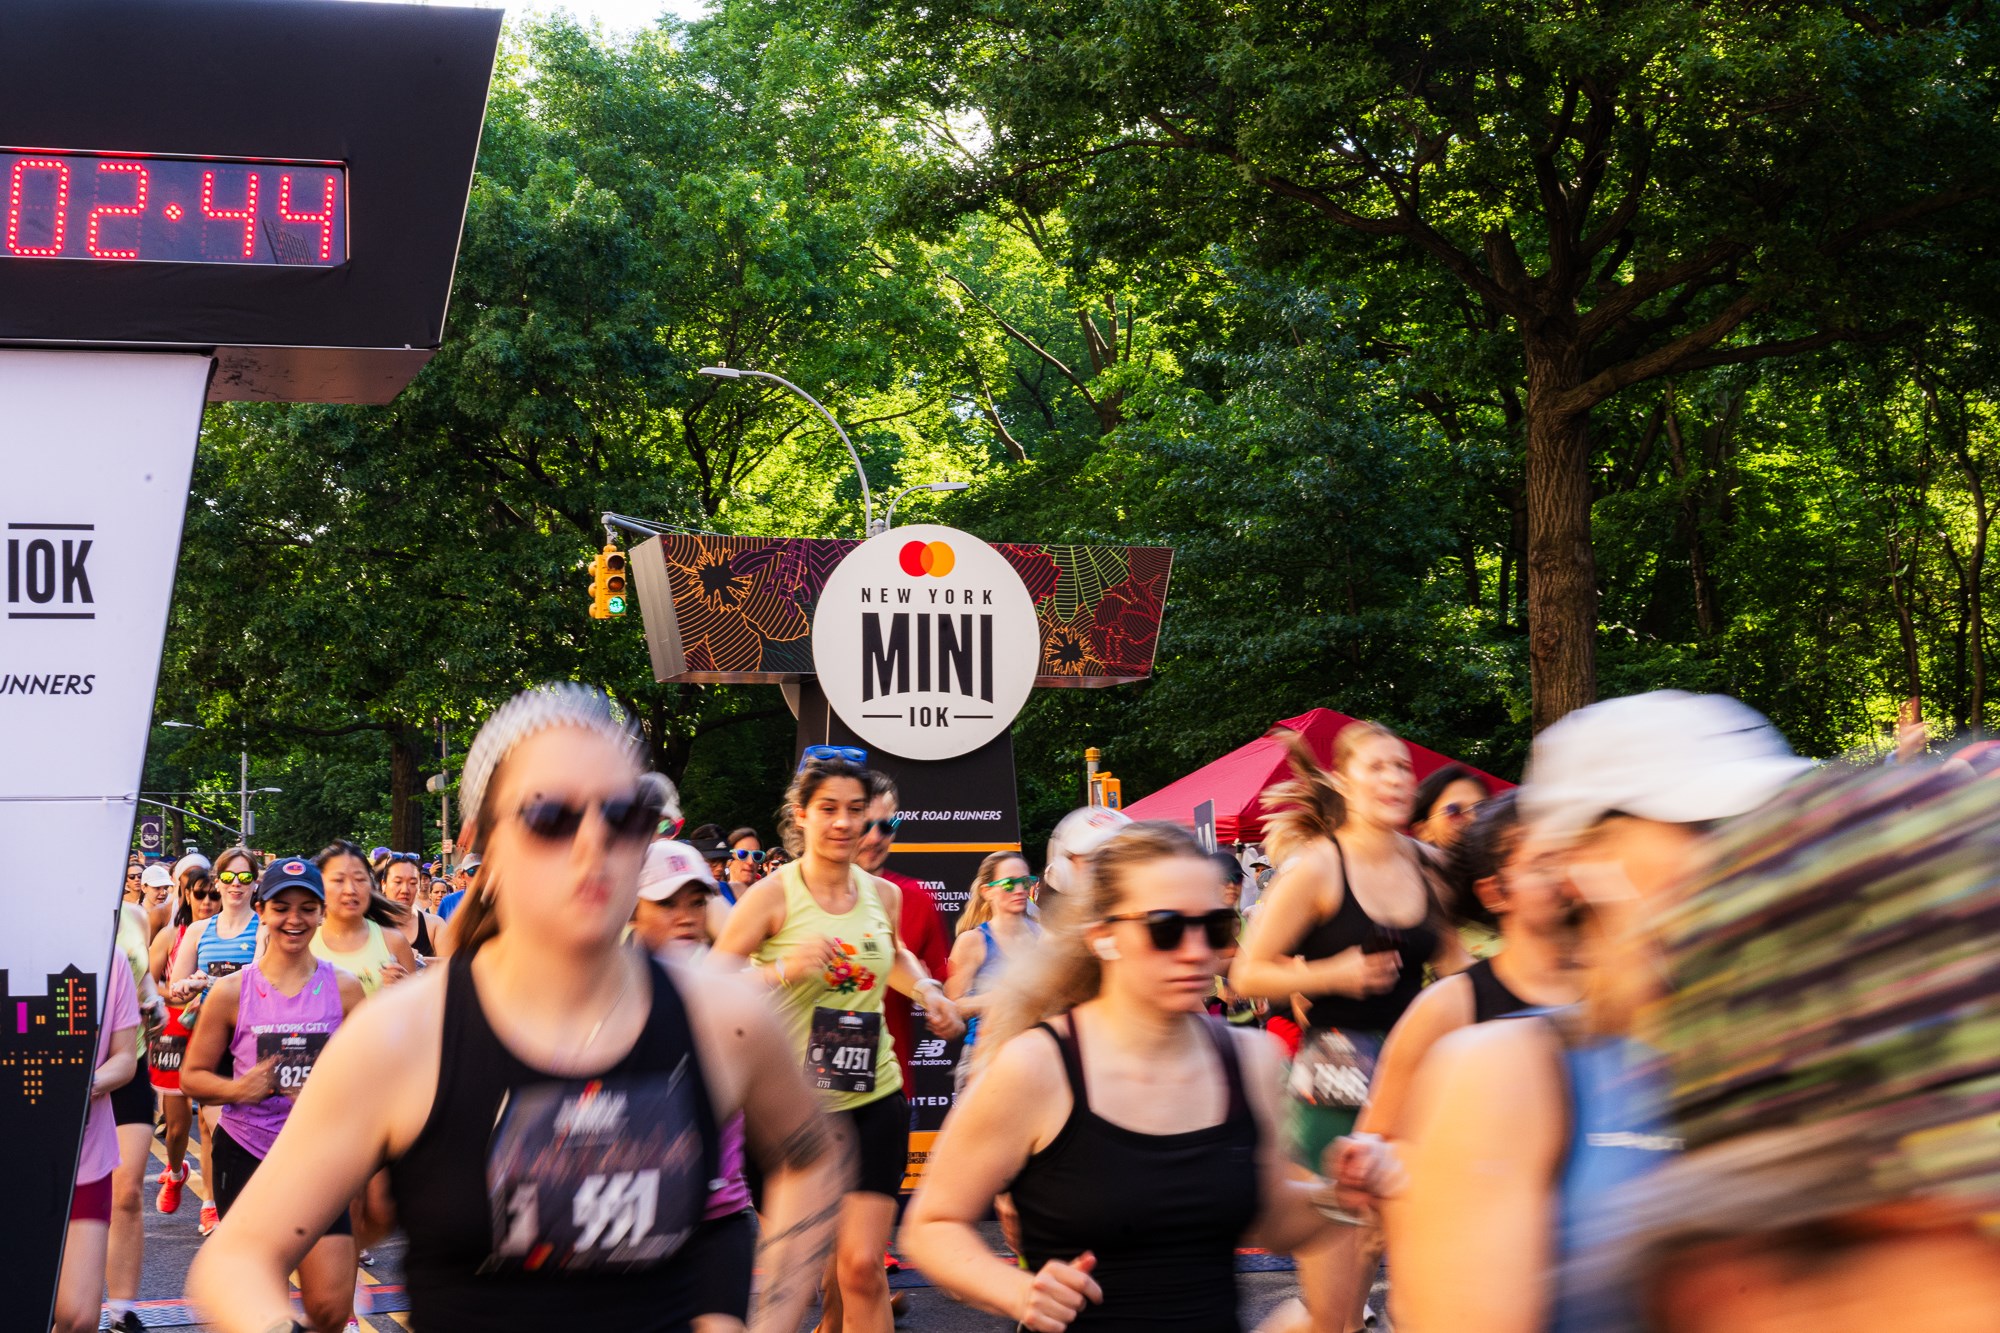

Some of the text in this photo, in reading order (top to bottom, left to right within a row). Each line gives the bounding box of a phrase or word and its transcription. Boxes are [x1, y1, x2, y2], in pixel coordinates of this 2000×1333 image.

[7, 538, 95, 604] 10K
[861, 587, 993, 605] NEW YORK
[862, 612, 993, 704] MINI
[909, 706, 950, 728] 10K
[895, 810, 1003, 821] ORK ROAD RUNNERS
[917, 881, 946, 890] TATA
[926, 891, 972, 901] NSULTAN
[933, 902, 960, 912] VICES
[251, 1022, 330, 1034] NEW YORK CITY
[831, 1046, 871, 1070] 4731
[907, 1096, 949, 1106] ITED
